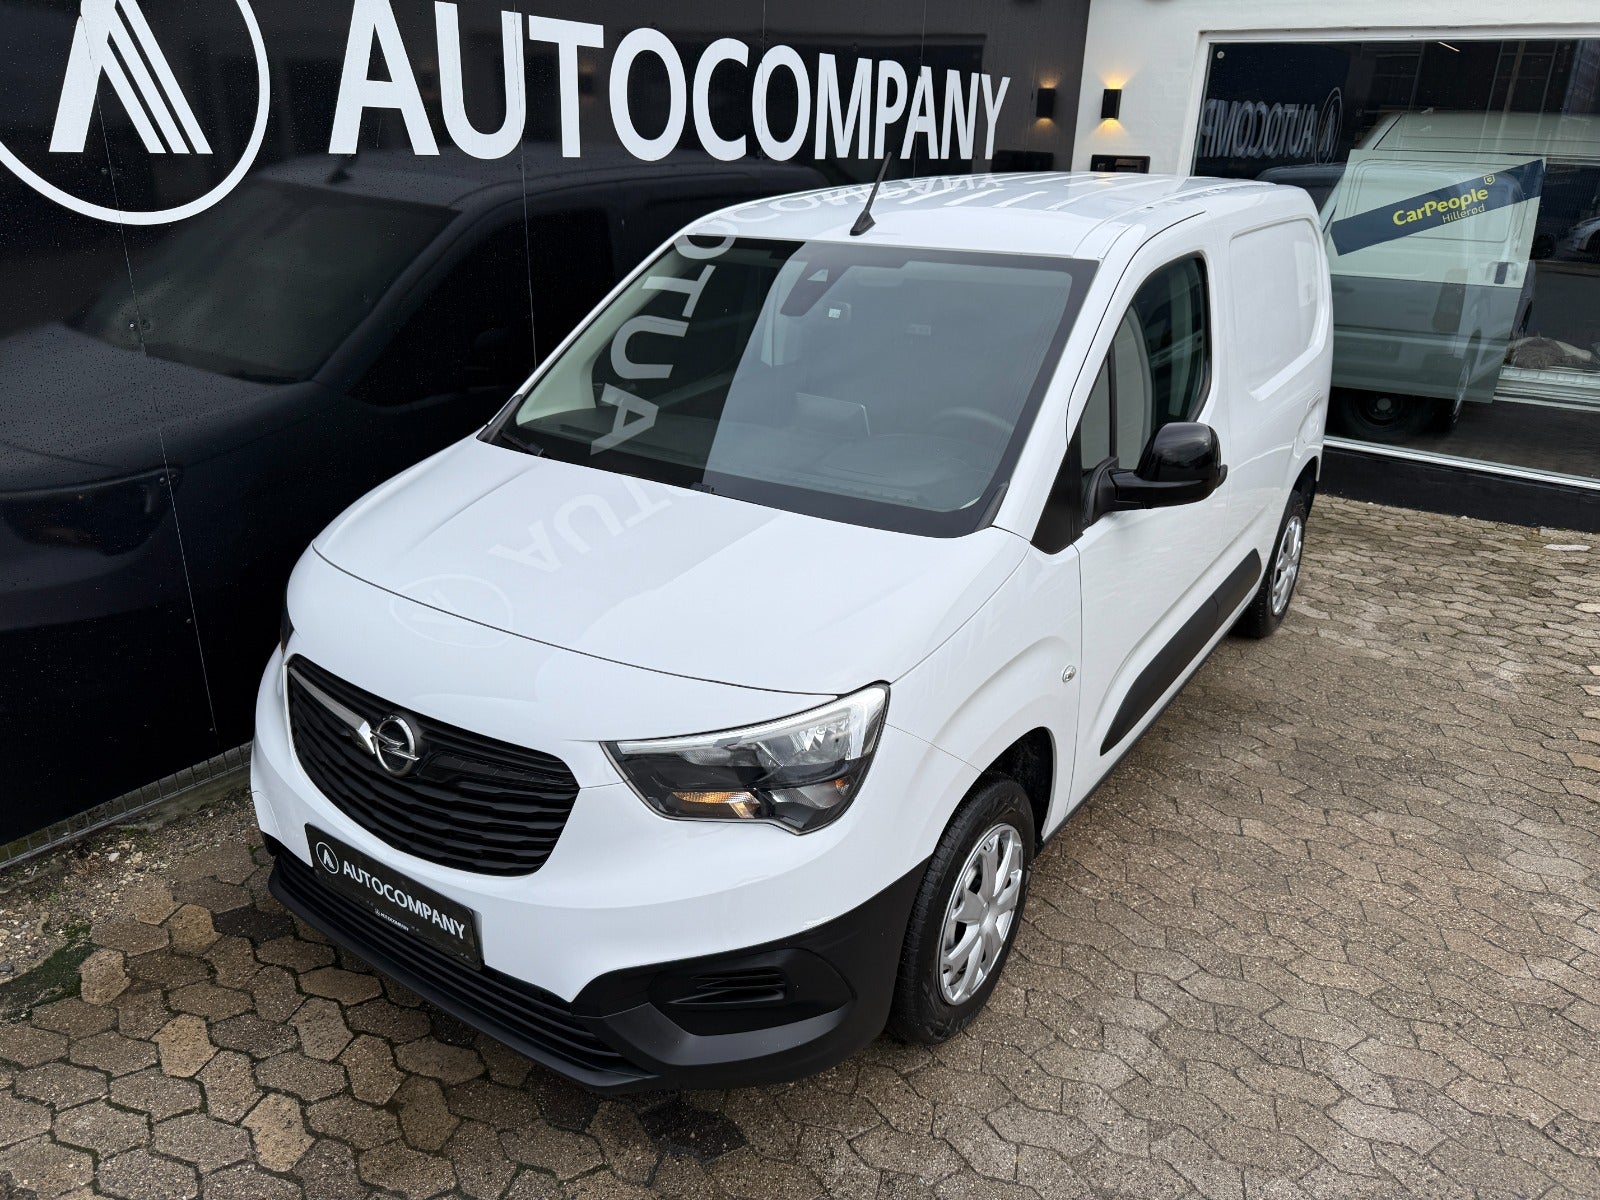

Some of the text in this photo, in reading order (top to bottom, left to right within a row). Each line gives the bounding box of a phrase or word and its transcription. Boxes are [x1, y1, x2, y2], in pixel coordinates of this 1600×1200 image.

[328, 0, 1011, 161] AUTOCOMPANY
[1392, 188, 1489, 226] CarPeople
[1442, 203, 1485, 223] Hillerød
[343, 860, 465, 940] AUTOCOMPANY
